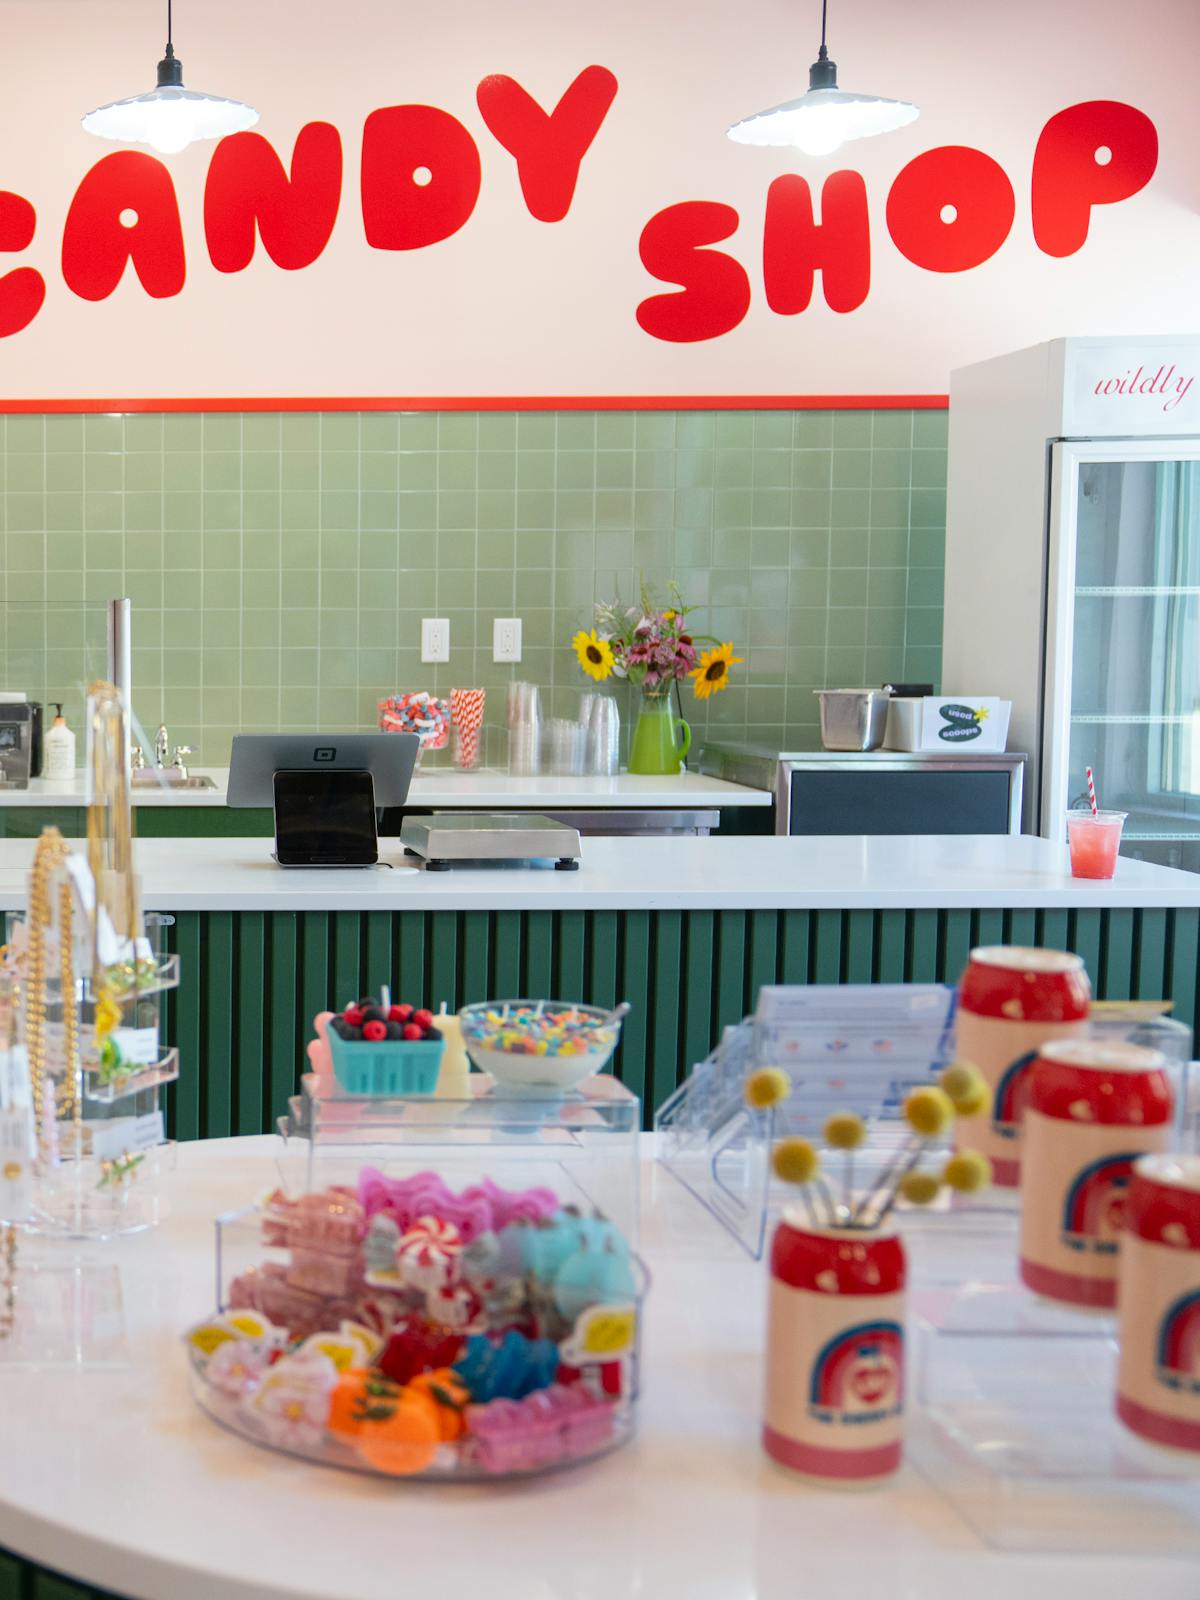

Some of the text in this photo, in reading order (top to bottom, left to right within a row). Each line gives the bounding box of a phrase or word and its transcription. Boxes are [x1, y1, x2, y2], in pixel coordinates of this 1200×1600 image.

[636, 101, 1158, 342] SHOP
[1094, 365, 1194, 411] wildly
[948, 710, 972, 720] used
[943, 728, 978, 738] scoops
